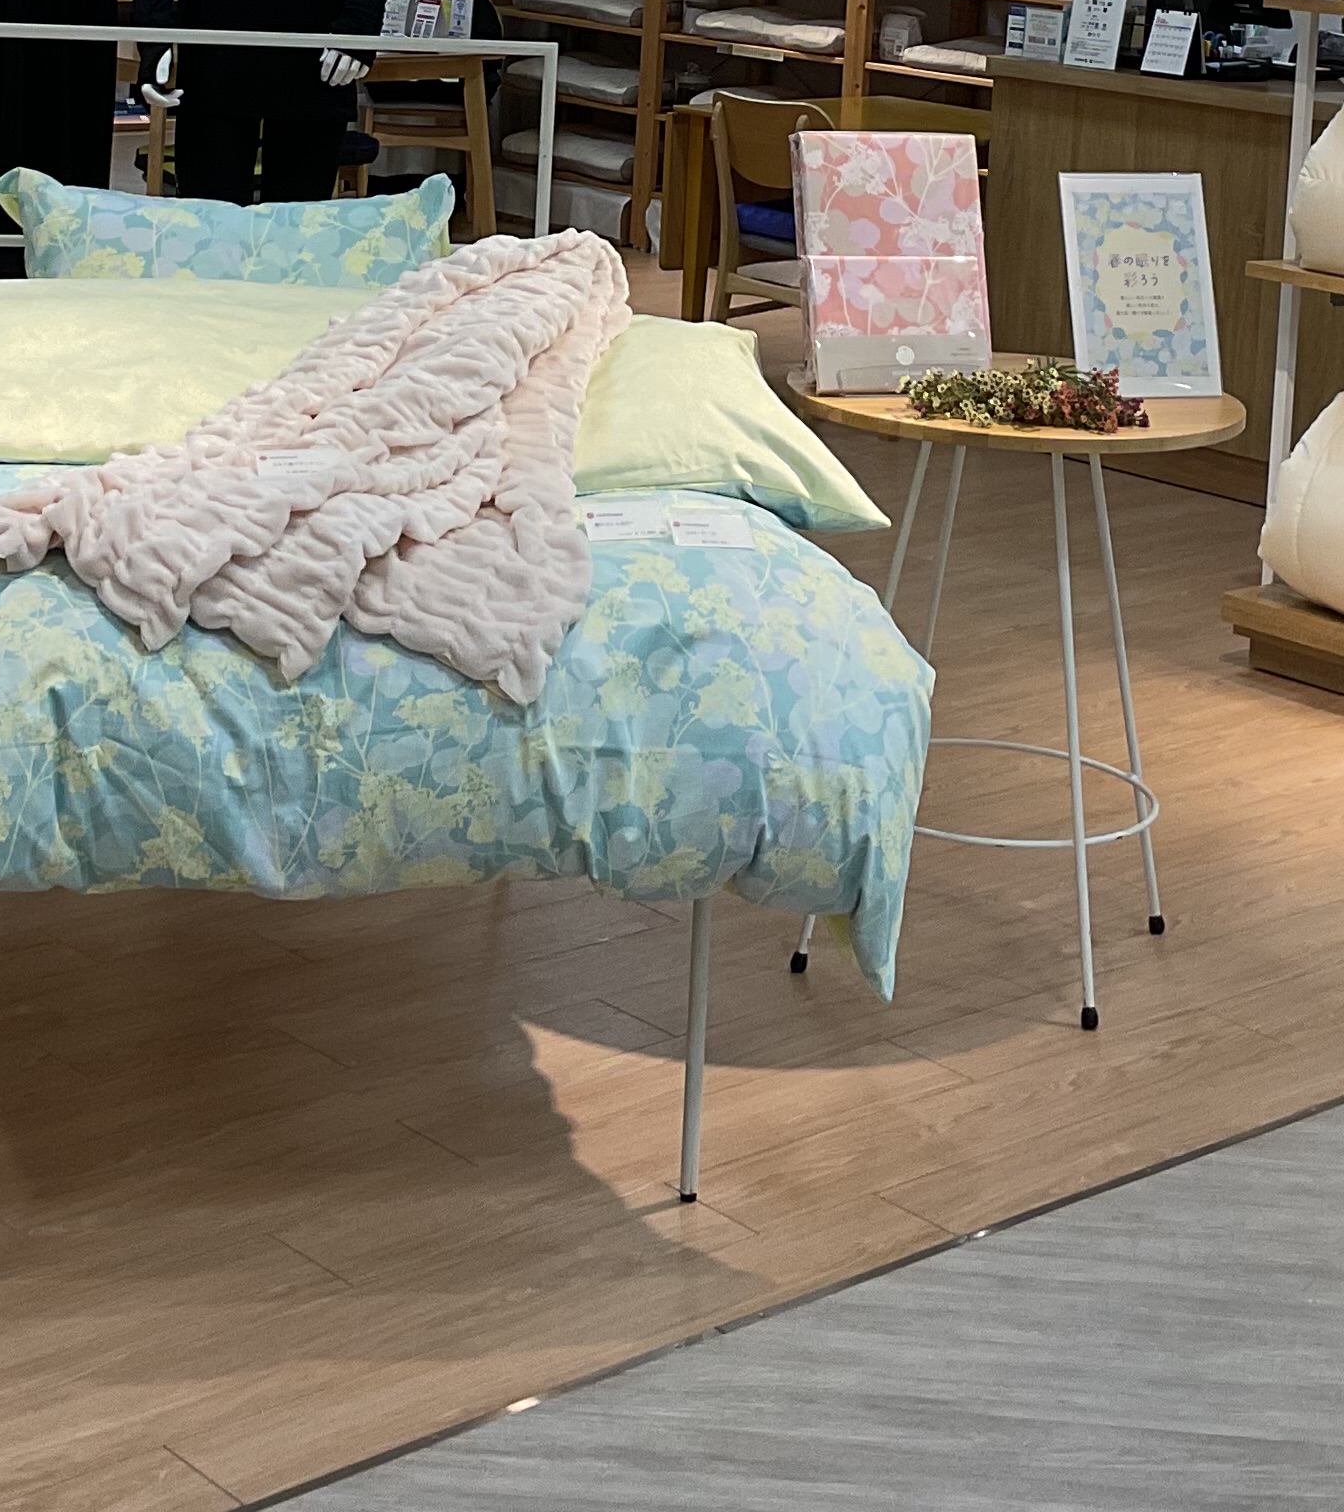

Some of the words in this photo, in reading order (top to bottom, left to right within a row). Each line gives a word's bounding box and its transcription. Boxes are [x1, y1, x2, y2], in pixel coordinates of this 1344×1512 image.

[1109, 253, 1170, 269] 春の眠りを
[1123, 271, 1159, 288] 彩ろう
